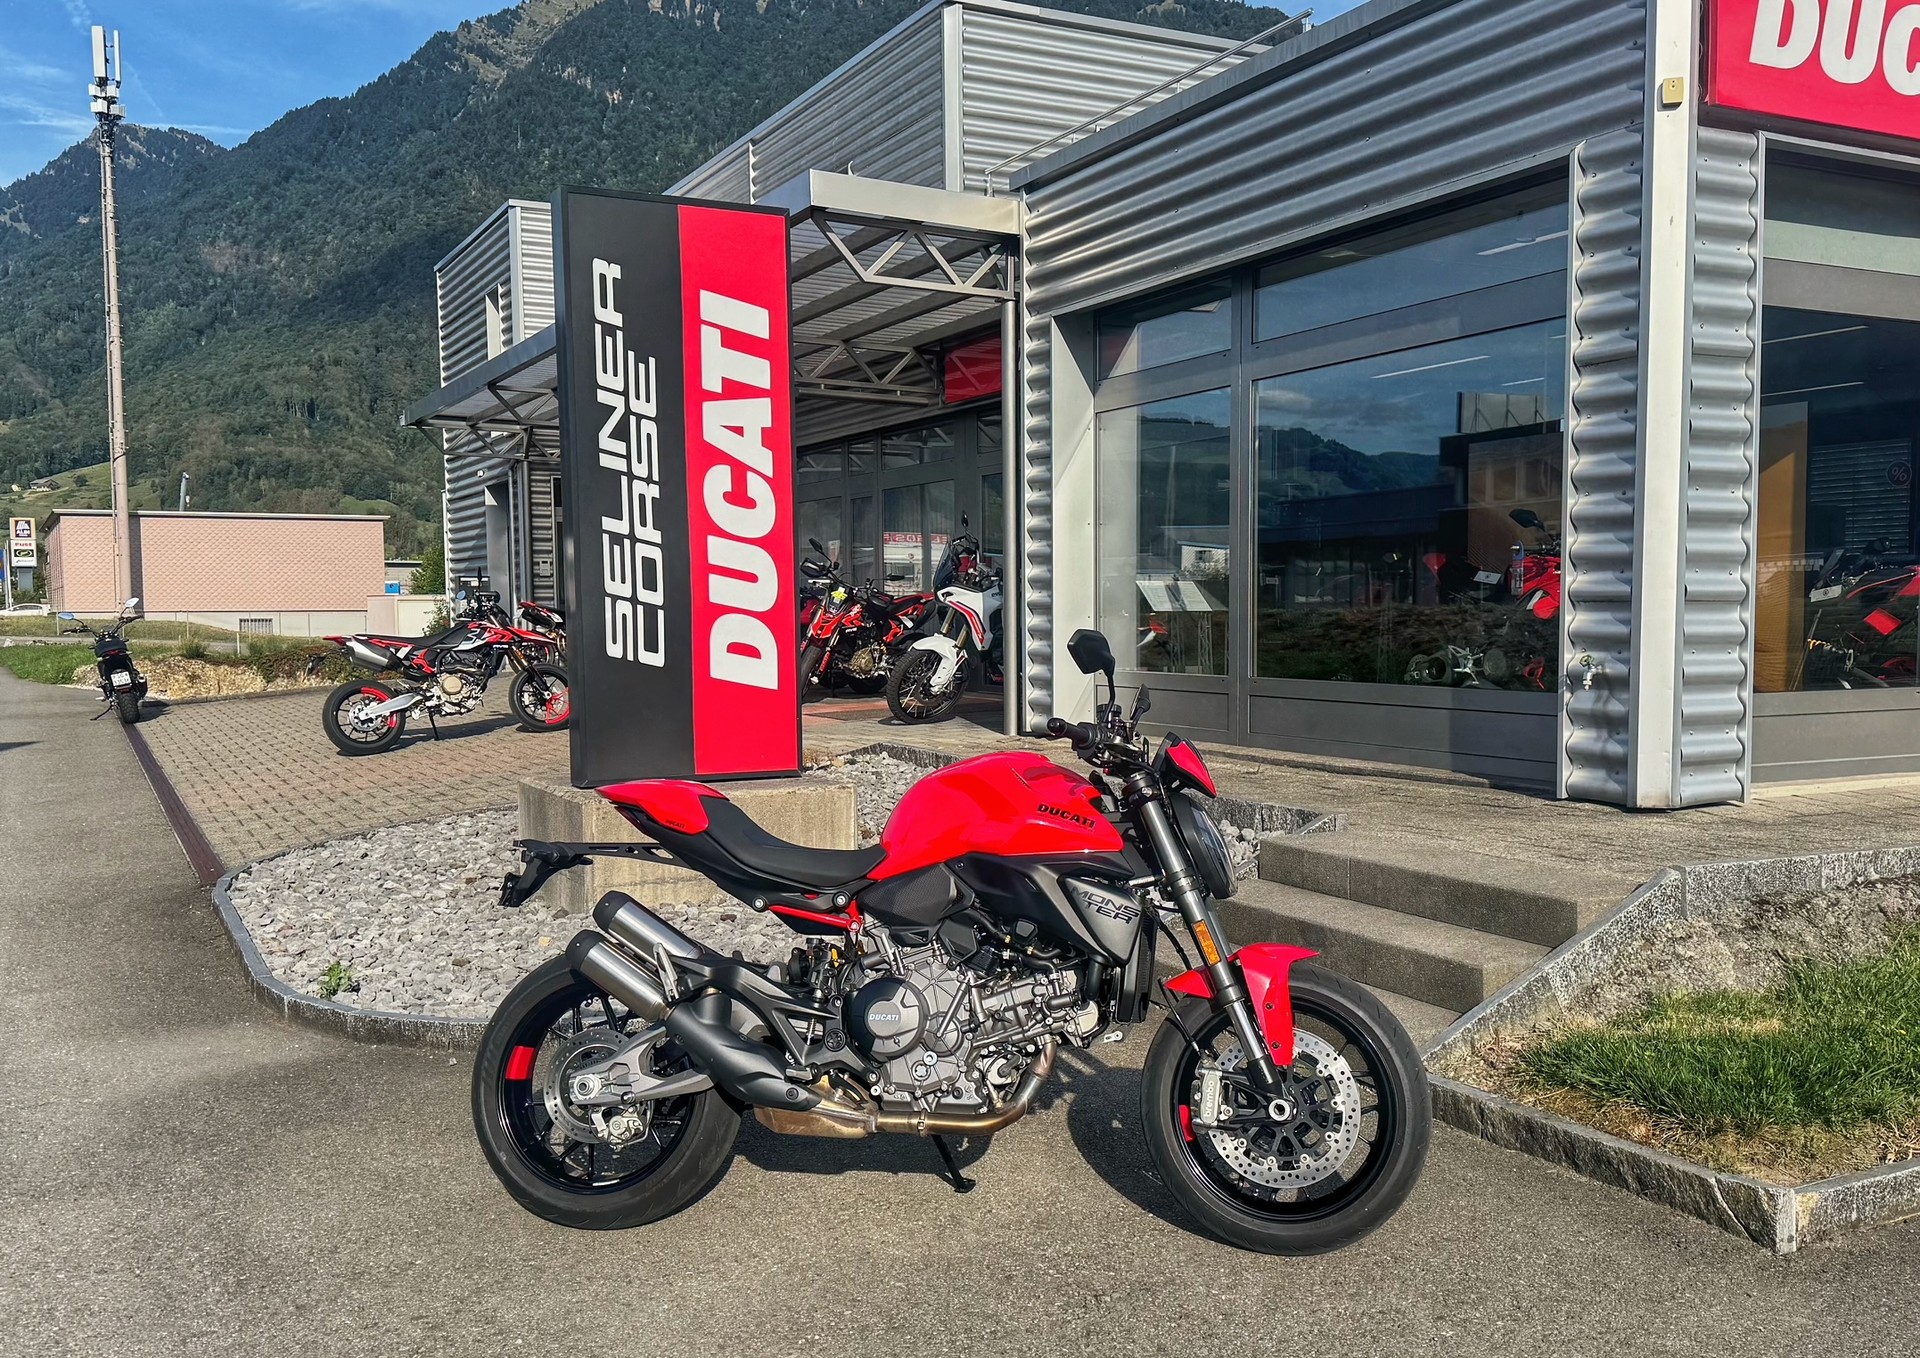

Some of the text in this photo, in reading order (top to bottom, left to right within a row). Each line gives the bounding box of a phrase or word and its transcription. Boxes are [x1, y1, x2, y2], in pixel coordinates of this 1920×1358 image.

[592, 257, 634, 662] SELINER
[699, 289, 779, 690] DUCATI
[627, 350, 666, 668] CORSE
[1037, 803, 1097, 829] DUCATI
[1070, 886, 1141, 919] MONS
[1086, 900, 1135, 925] TER
[868, 1013, 899, 1022] DUCATI
[1203, 1080, 1215, 1117] brembo
